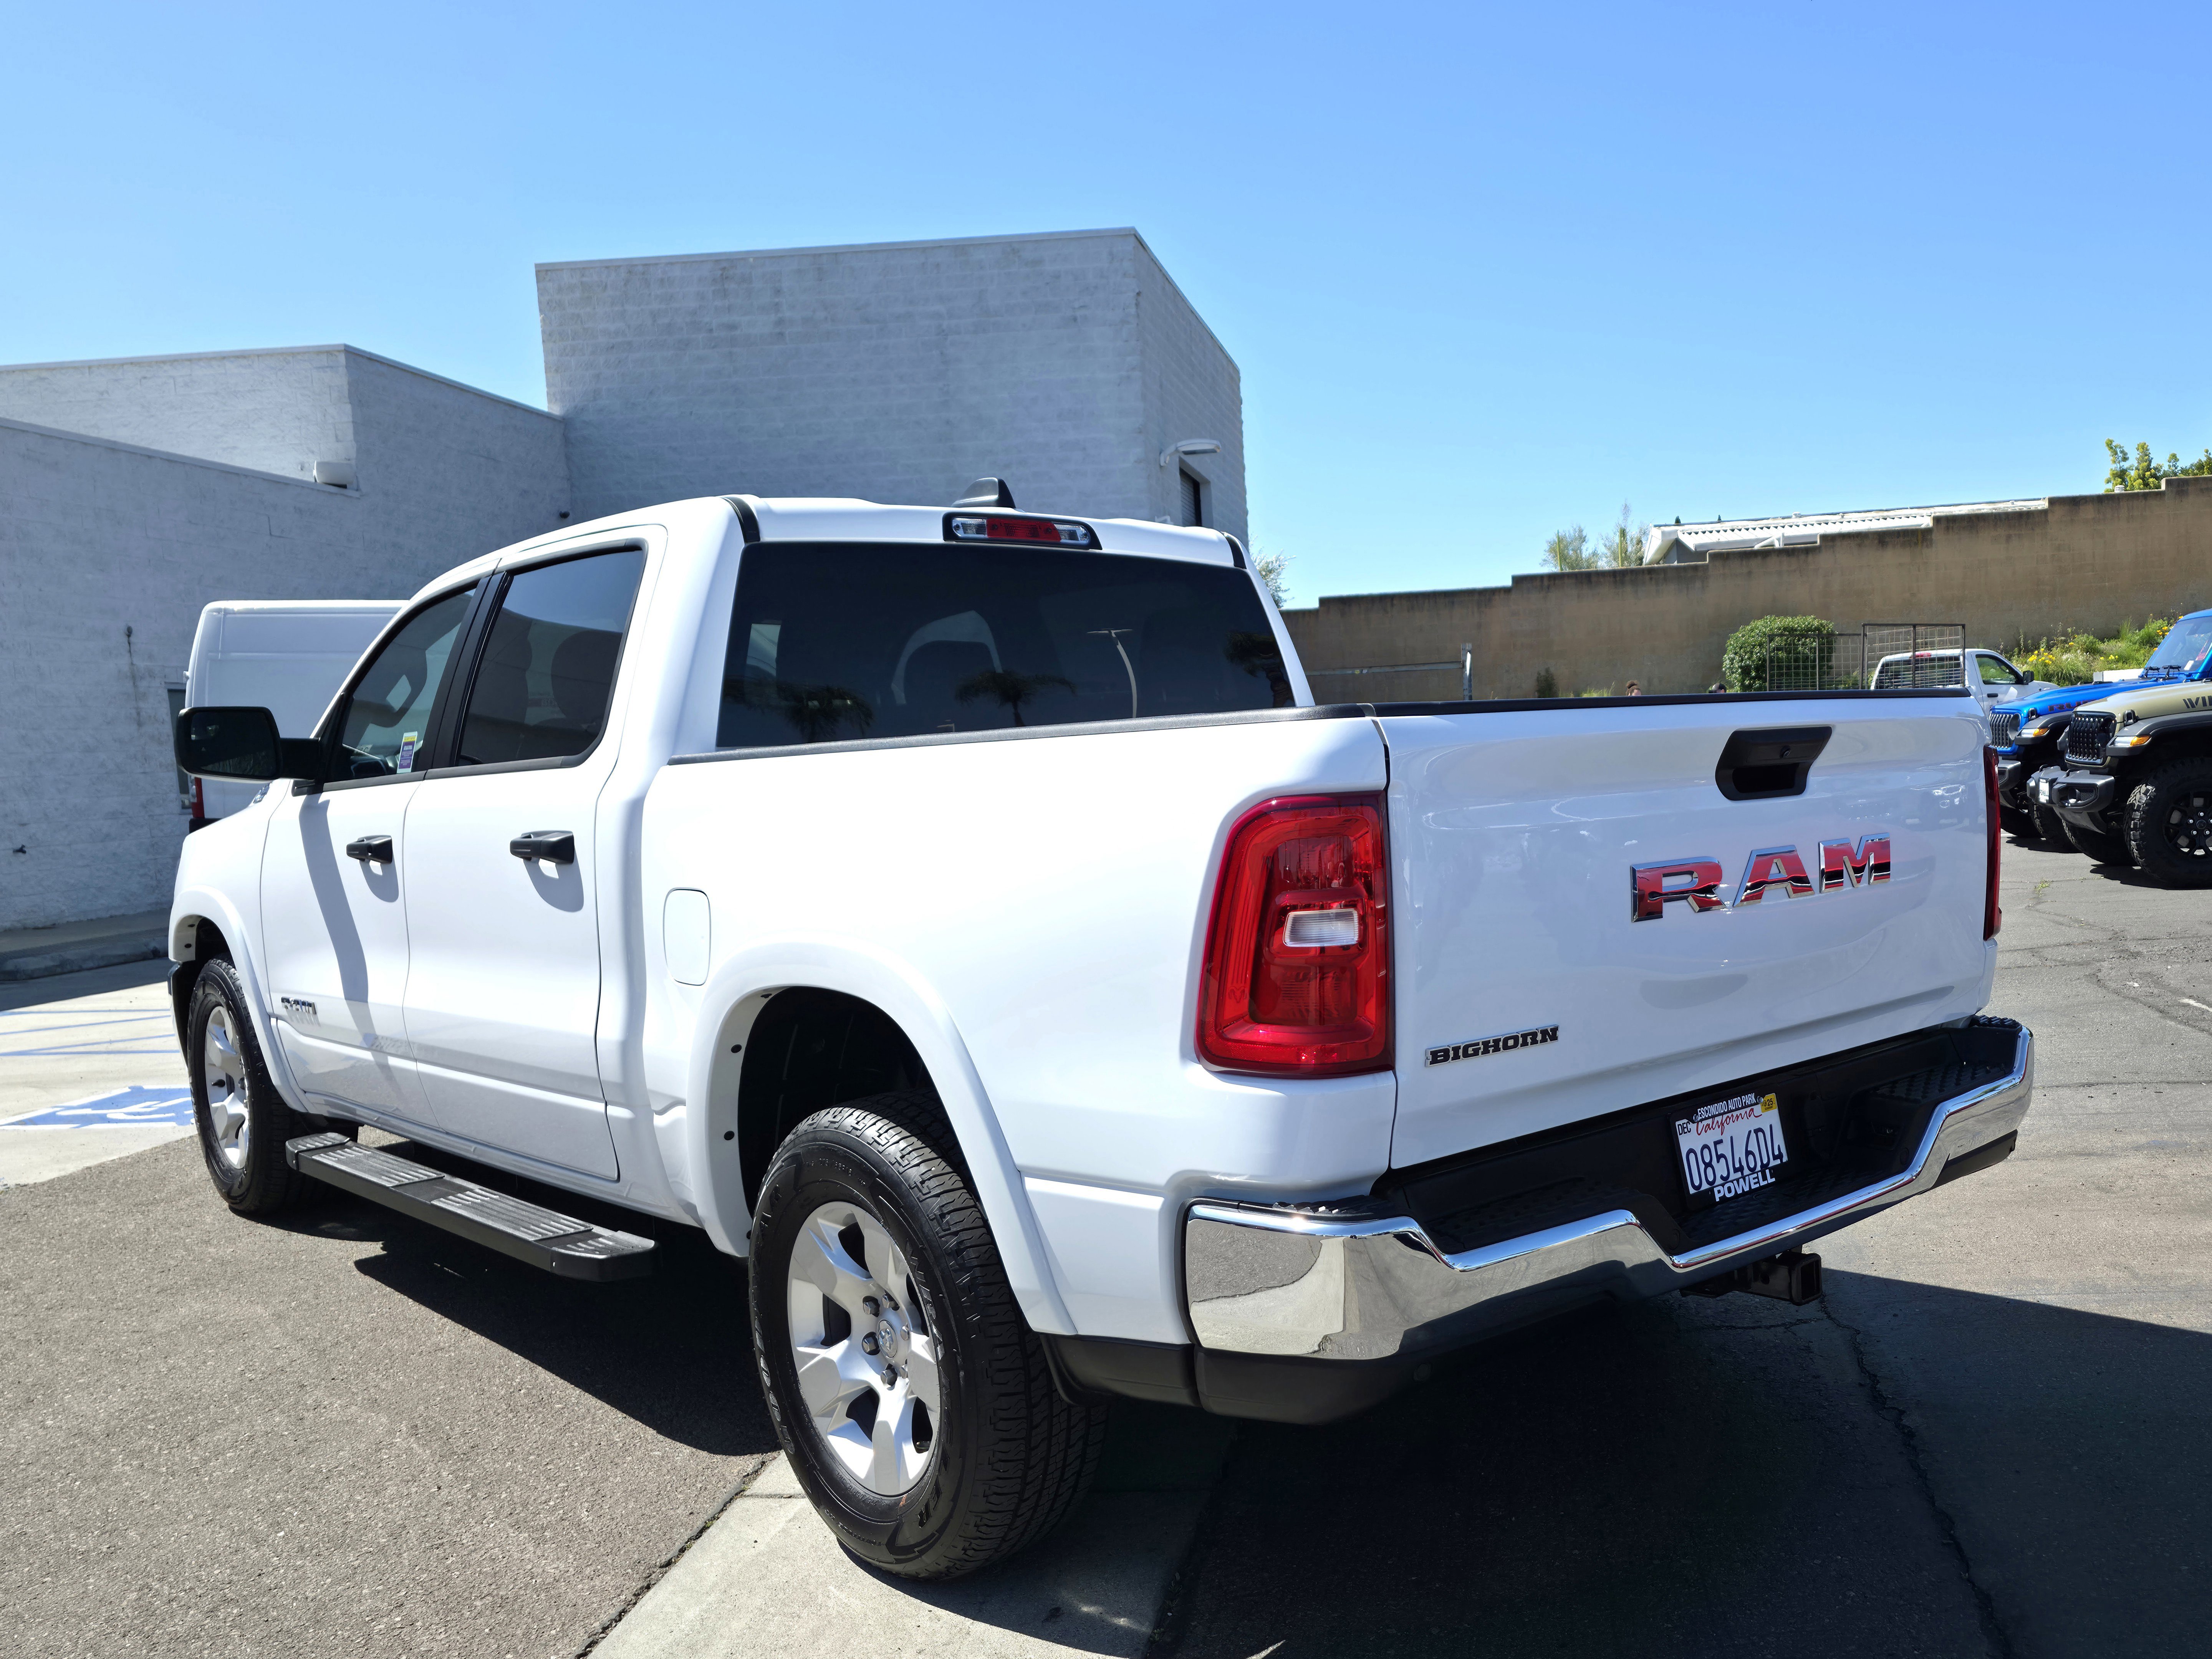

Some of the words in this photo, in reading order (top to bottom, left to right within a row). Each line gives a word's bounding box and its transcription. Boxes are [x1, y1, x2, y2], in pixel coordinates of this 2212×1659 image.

[1631, 832, 1891, 922] RAM
[281, 996, 317, 1015] RAM
[1425, 1024, 1560, 1067] BIGHORN
[1697, 1101, 1727, 1119] ESCONDIDO
[1728, 1097, 1742, 1111] AUTO
[1742, 1093, 1756, 1106] PARK
[1767, 1098, 1773, 1106] 25
[1677, 1121, 1691, 1136] DEC
[1696, 1108, 1762, 1136] California
[1685, 1124, 1784, 1191] 08546D4
[1714, 1169, 1776, 1202] POWELL
